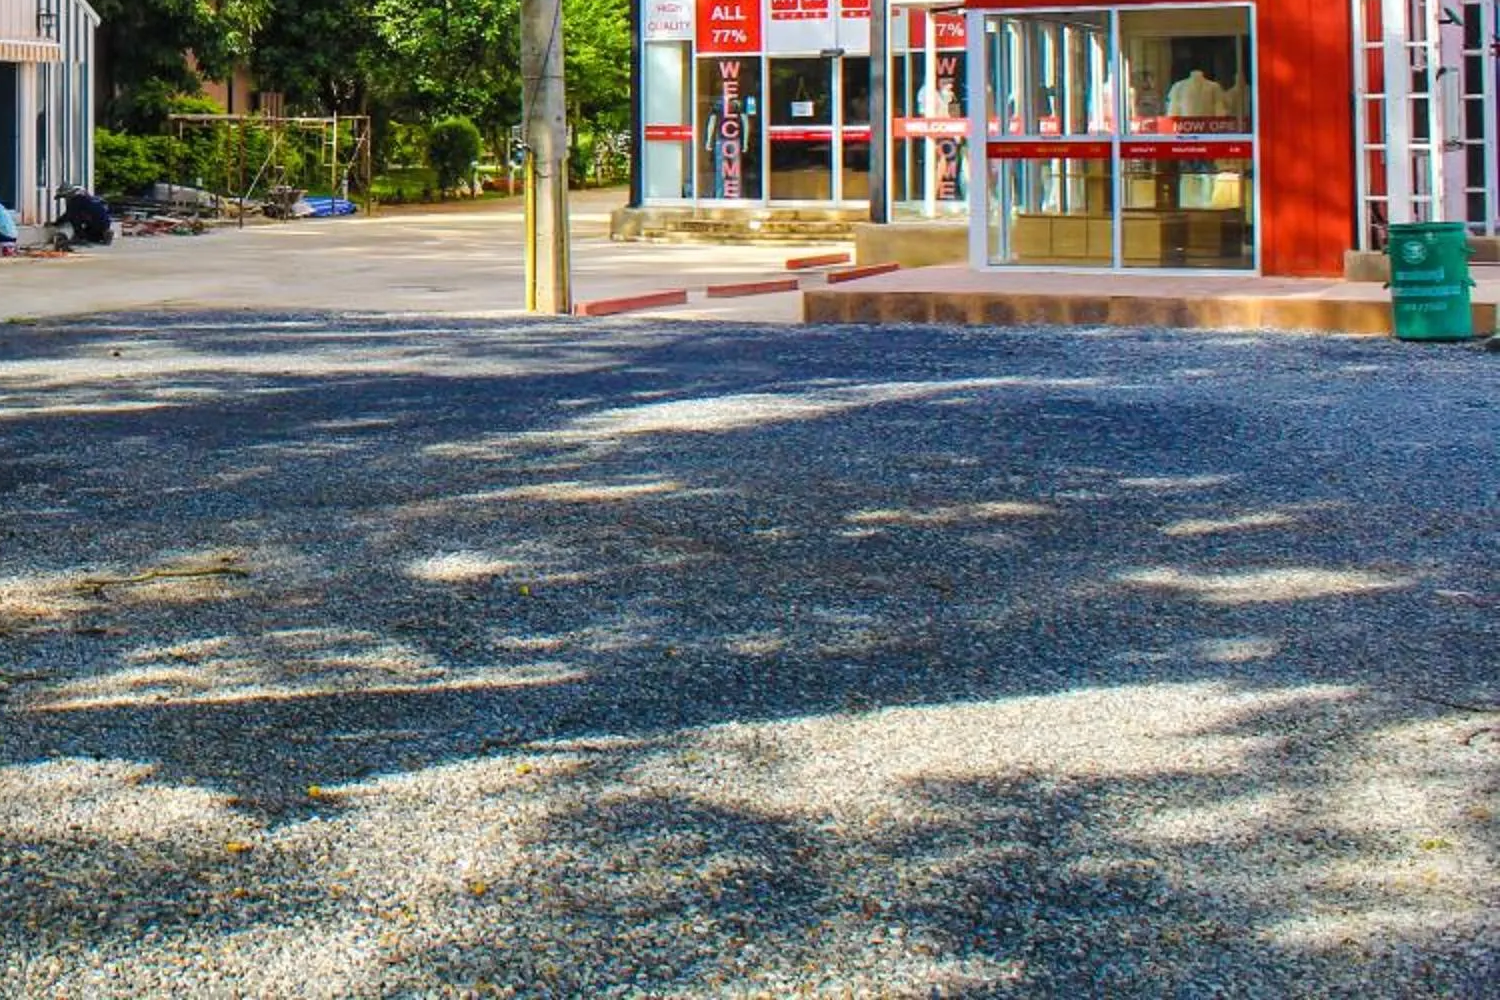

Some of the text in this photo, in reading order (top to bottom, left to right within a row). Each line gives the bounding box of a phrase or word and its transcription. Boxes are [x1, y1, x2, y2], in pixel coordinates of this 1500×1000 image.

[711, 5, 747, 21] ALL
[711, 29, 748, 43] 77%
[936, 22, 964, 36] 7%
[719, 61, 740, 197] WELCOME
